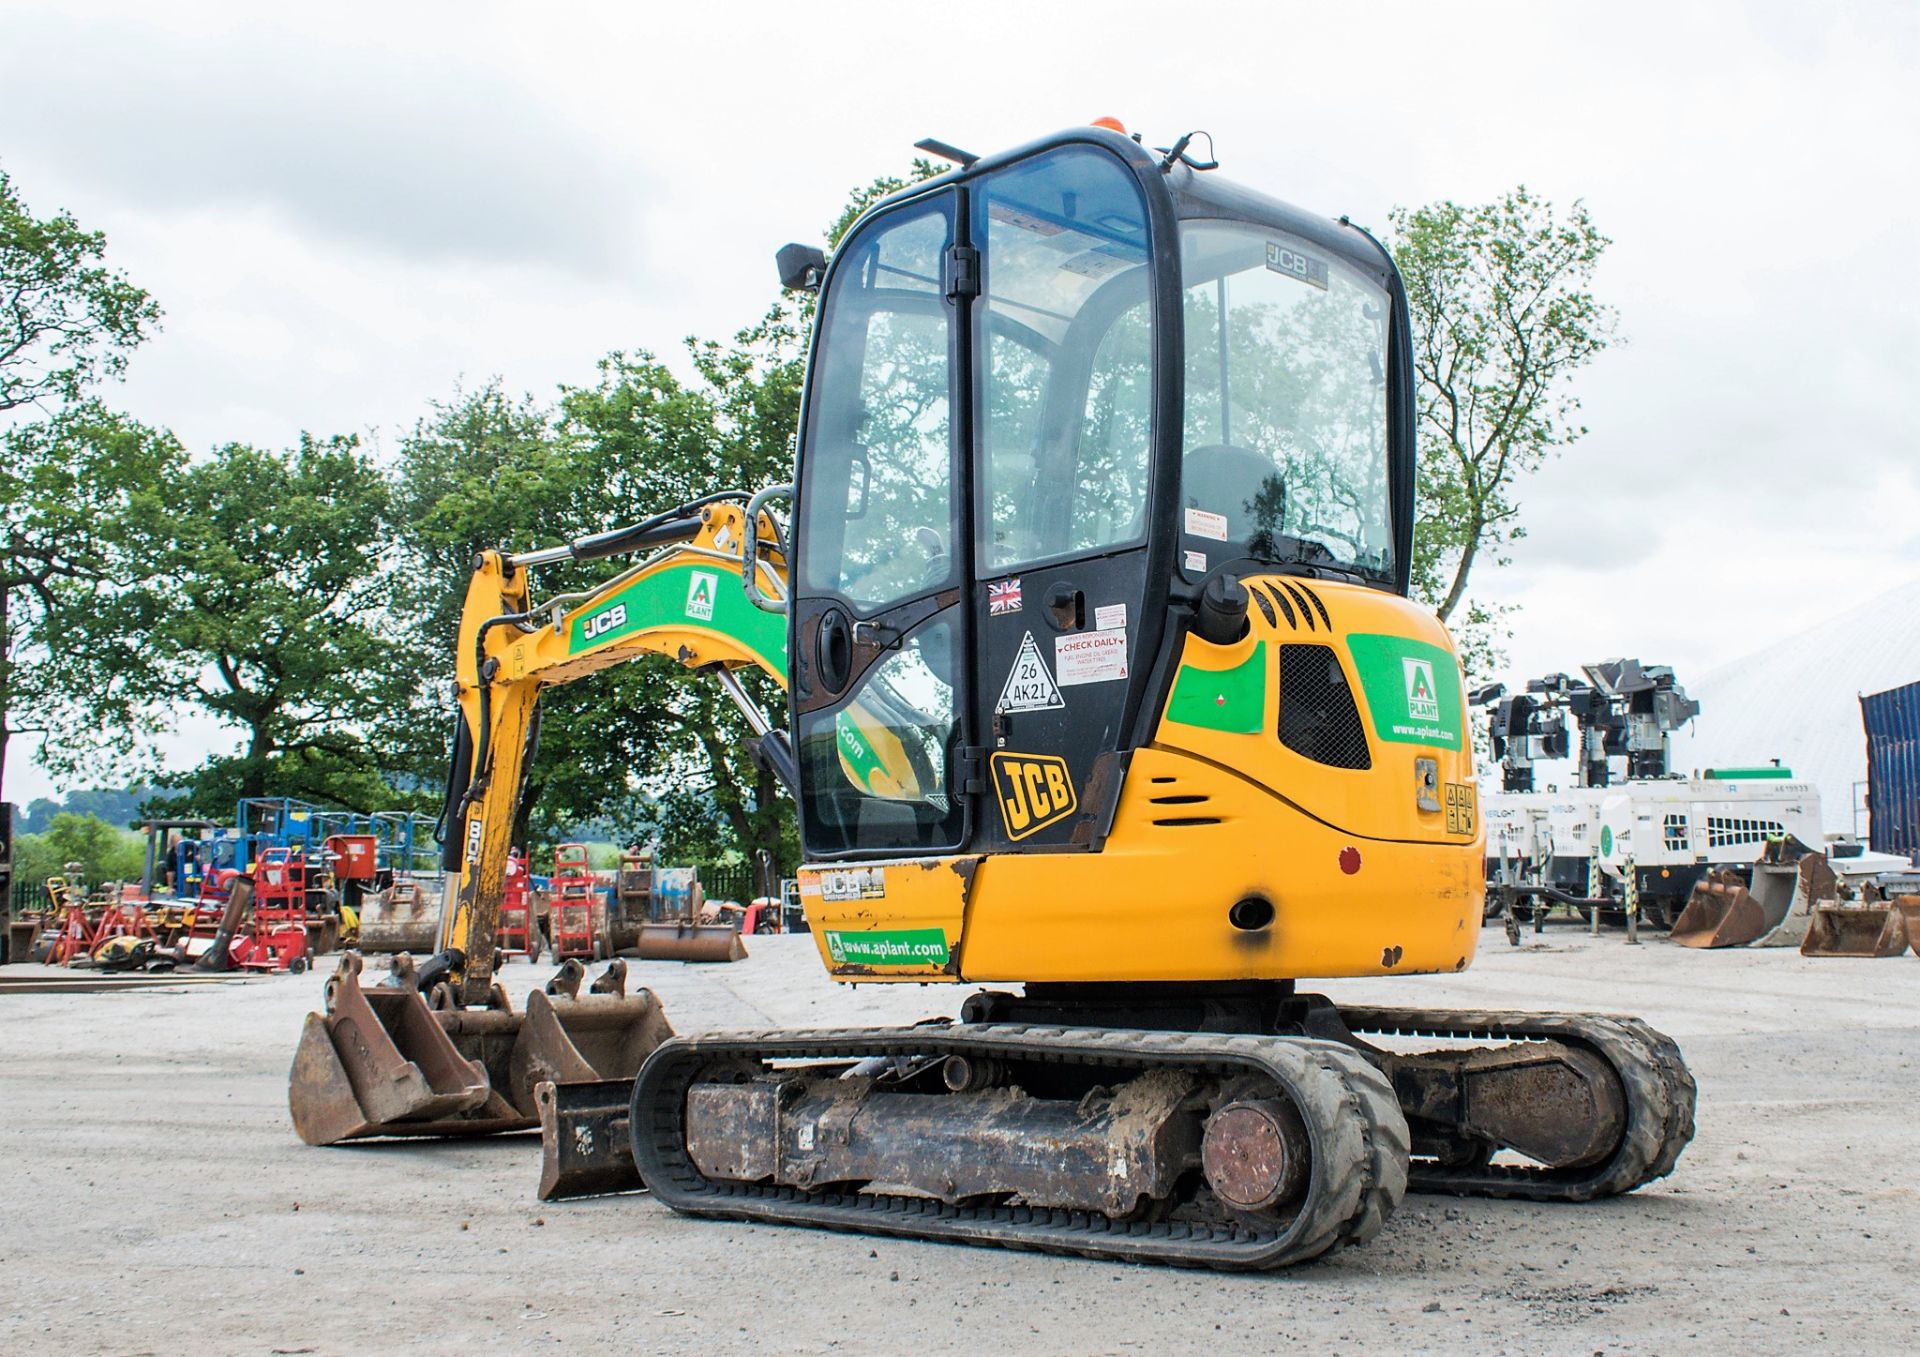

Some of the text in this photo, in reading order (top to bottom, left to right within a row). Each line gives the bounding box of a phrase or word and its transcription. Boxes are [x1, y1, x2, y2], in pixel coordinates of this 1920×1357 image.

[1267, 245, 1308, 275] JCB
[691, 577, 711, 605] A
[585, 603, 627, 640] JCB
[687, 604, 712, 618] PLANT
[1063, 637, 1118, 652] CHECK DAILY
[1021, 662, 1037, 680] 26
[1410, 665, 1435, 700] A
[1409, 702, 1438, 718] PLANT
[1392, 724, 1454, 740] www.aplant.com
[1002, 761, 1069, 830] JCB
[822, 873, 860, 895] JCB
[843, 939, 944, 960] www.aplant.com
